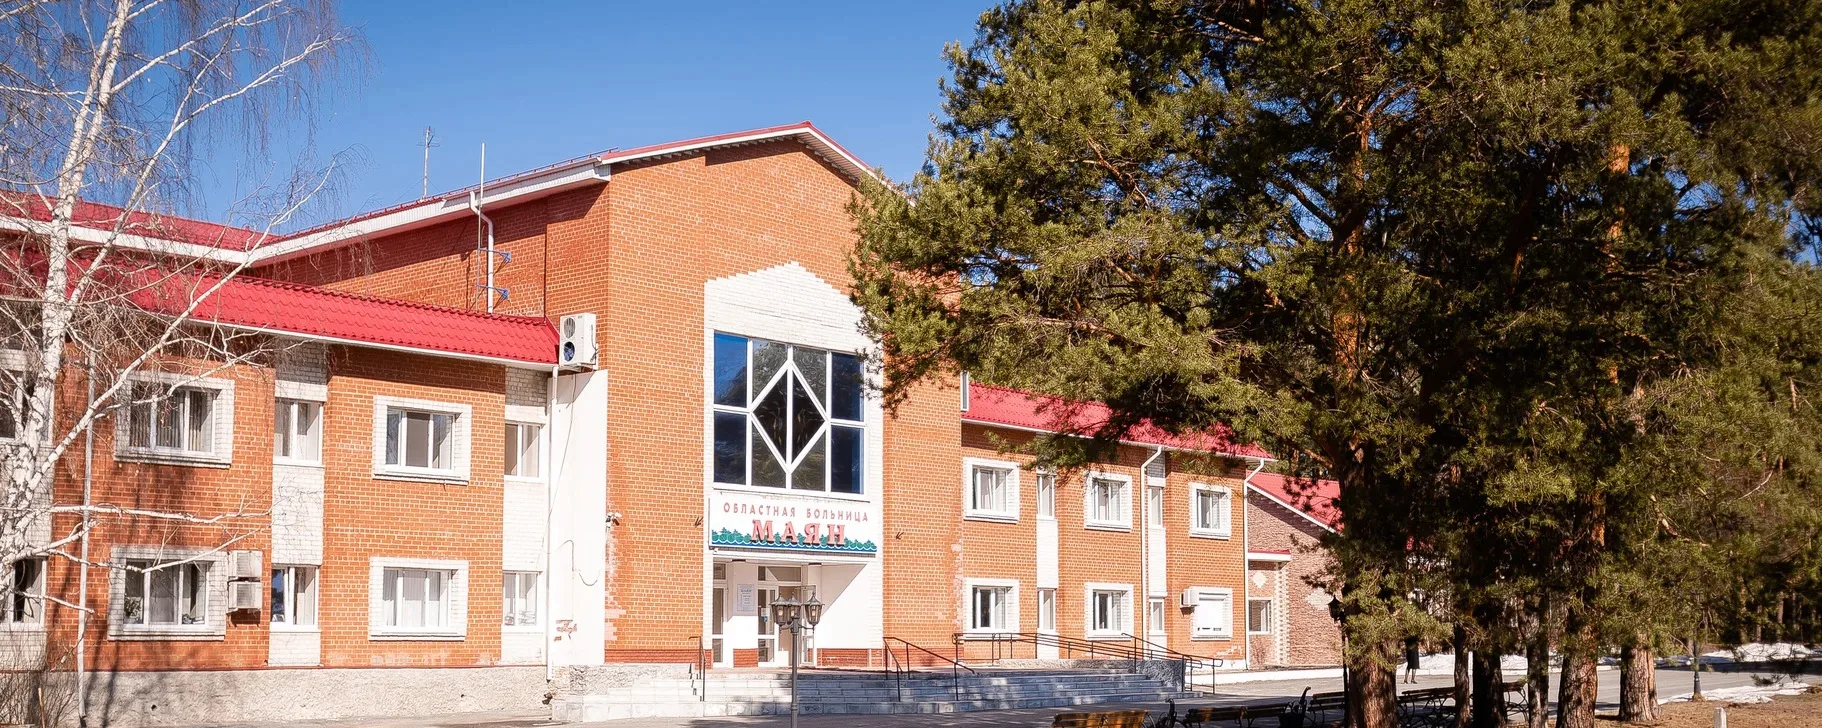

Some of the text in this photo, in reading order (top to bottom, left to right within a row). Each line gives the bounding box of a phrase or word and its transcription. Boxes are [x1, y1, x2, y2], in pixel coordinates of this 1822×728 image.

[723, 502, 869, 523] ОБЛАСТНАЯ БОЛЬНИЦА
[750, 519, 846, 546] МАЯН
